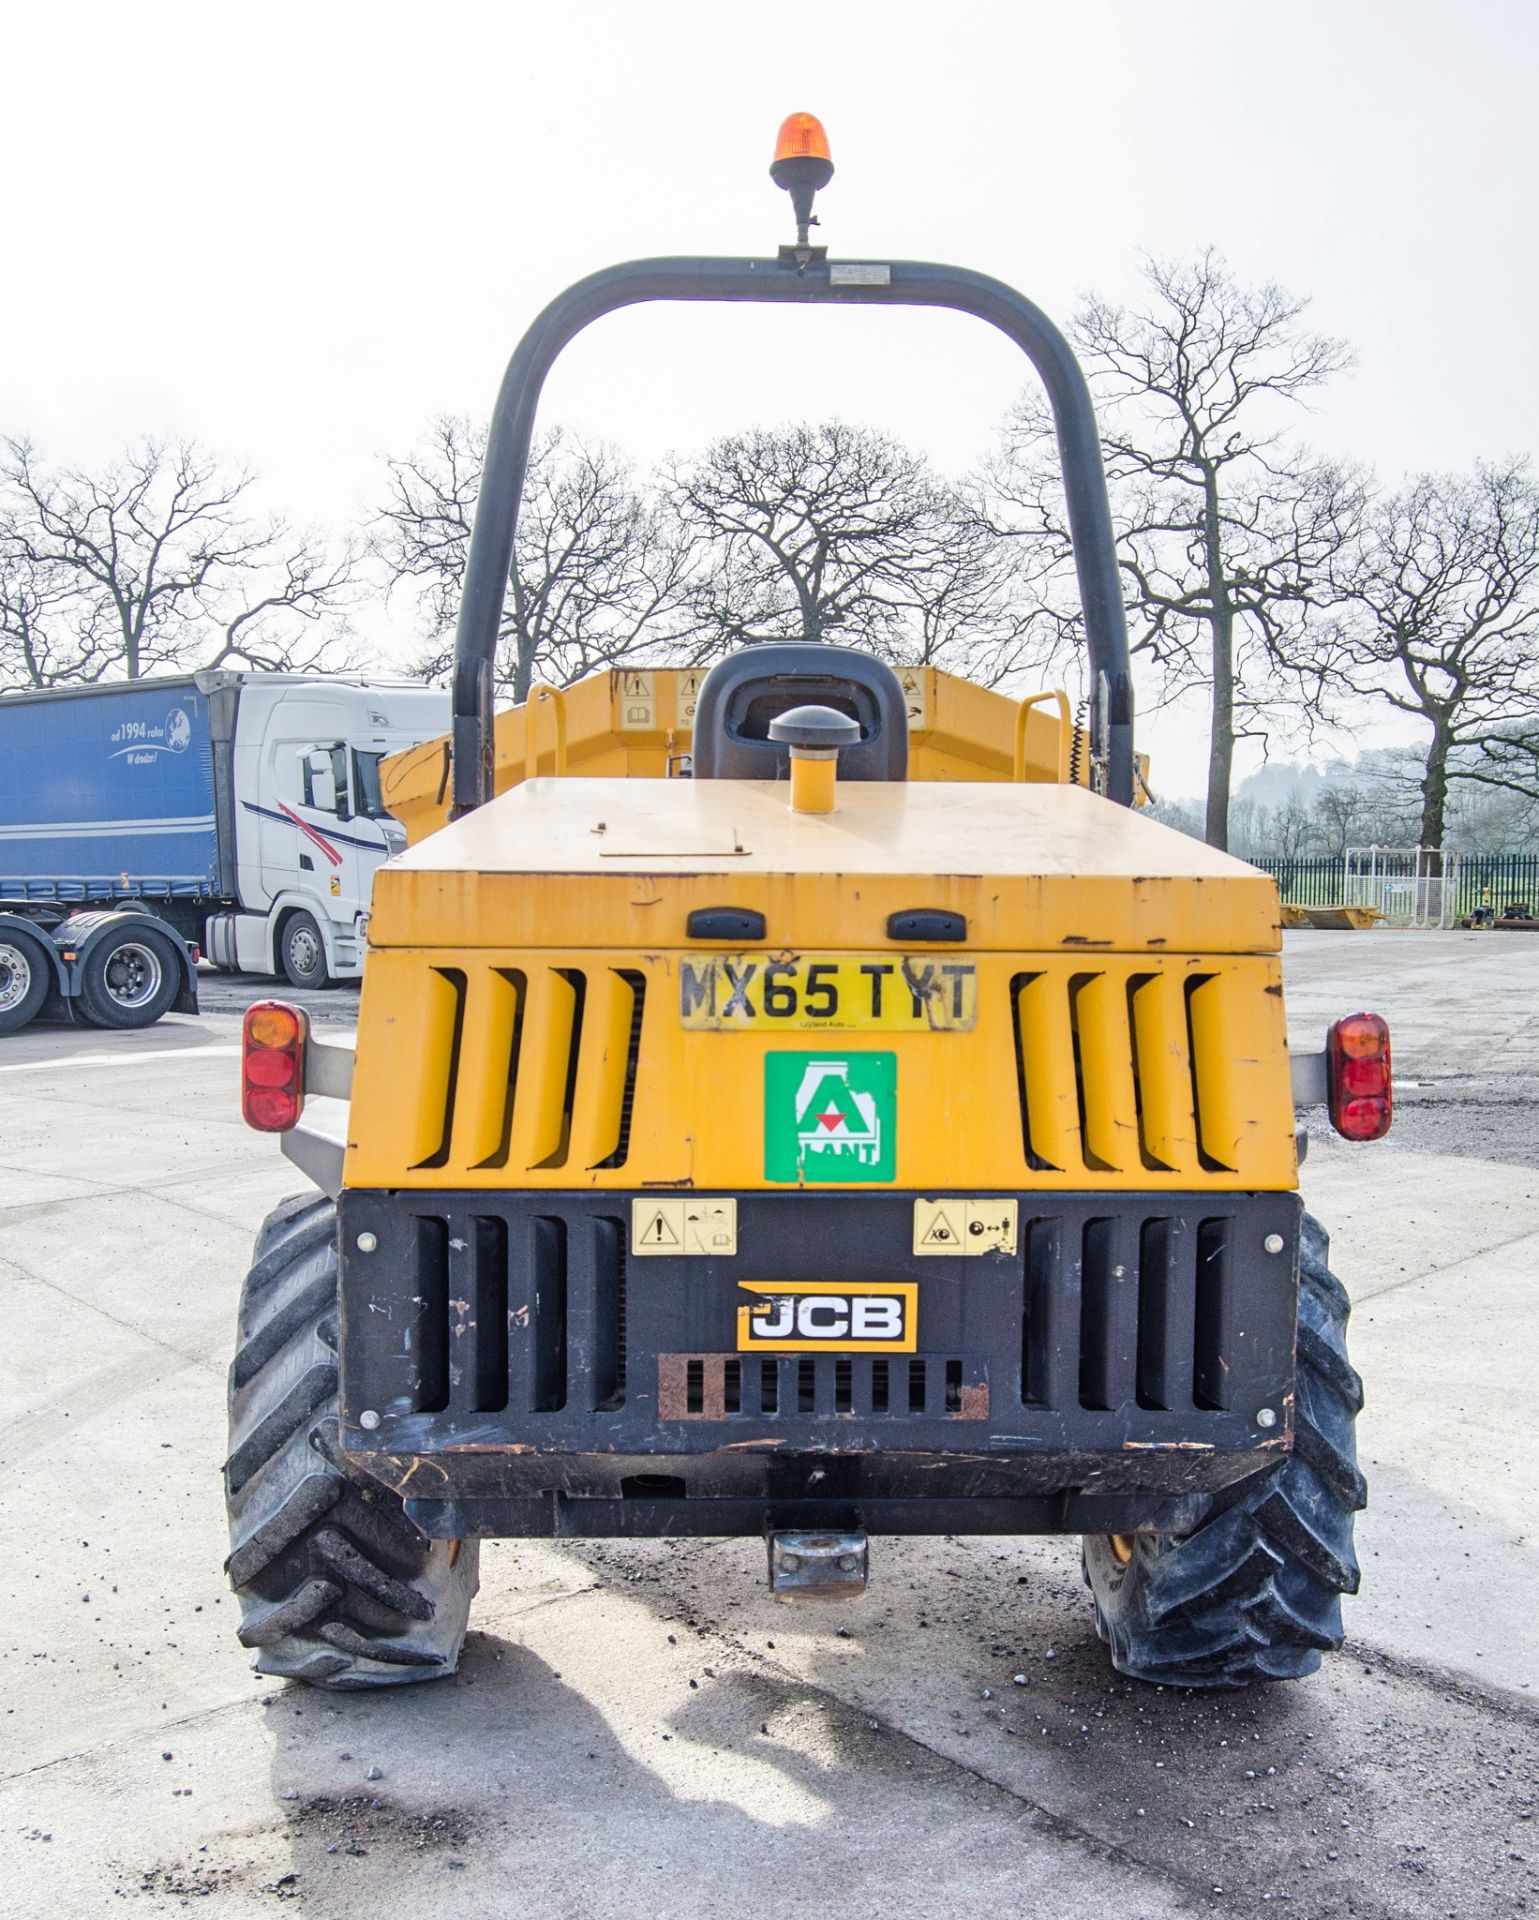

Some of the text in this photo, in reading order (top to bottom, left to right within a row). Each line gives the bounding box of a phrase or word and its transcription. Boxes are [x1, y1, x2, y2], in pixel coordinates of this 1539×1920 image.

[111, 722, 164, 741] od 1994 roku
[127, 753, 135, 765] W
[682, 963, 975, 1018] MX65 TYT
[752, 1296, 903, 1338] JCB
